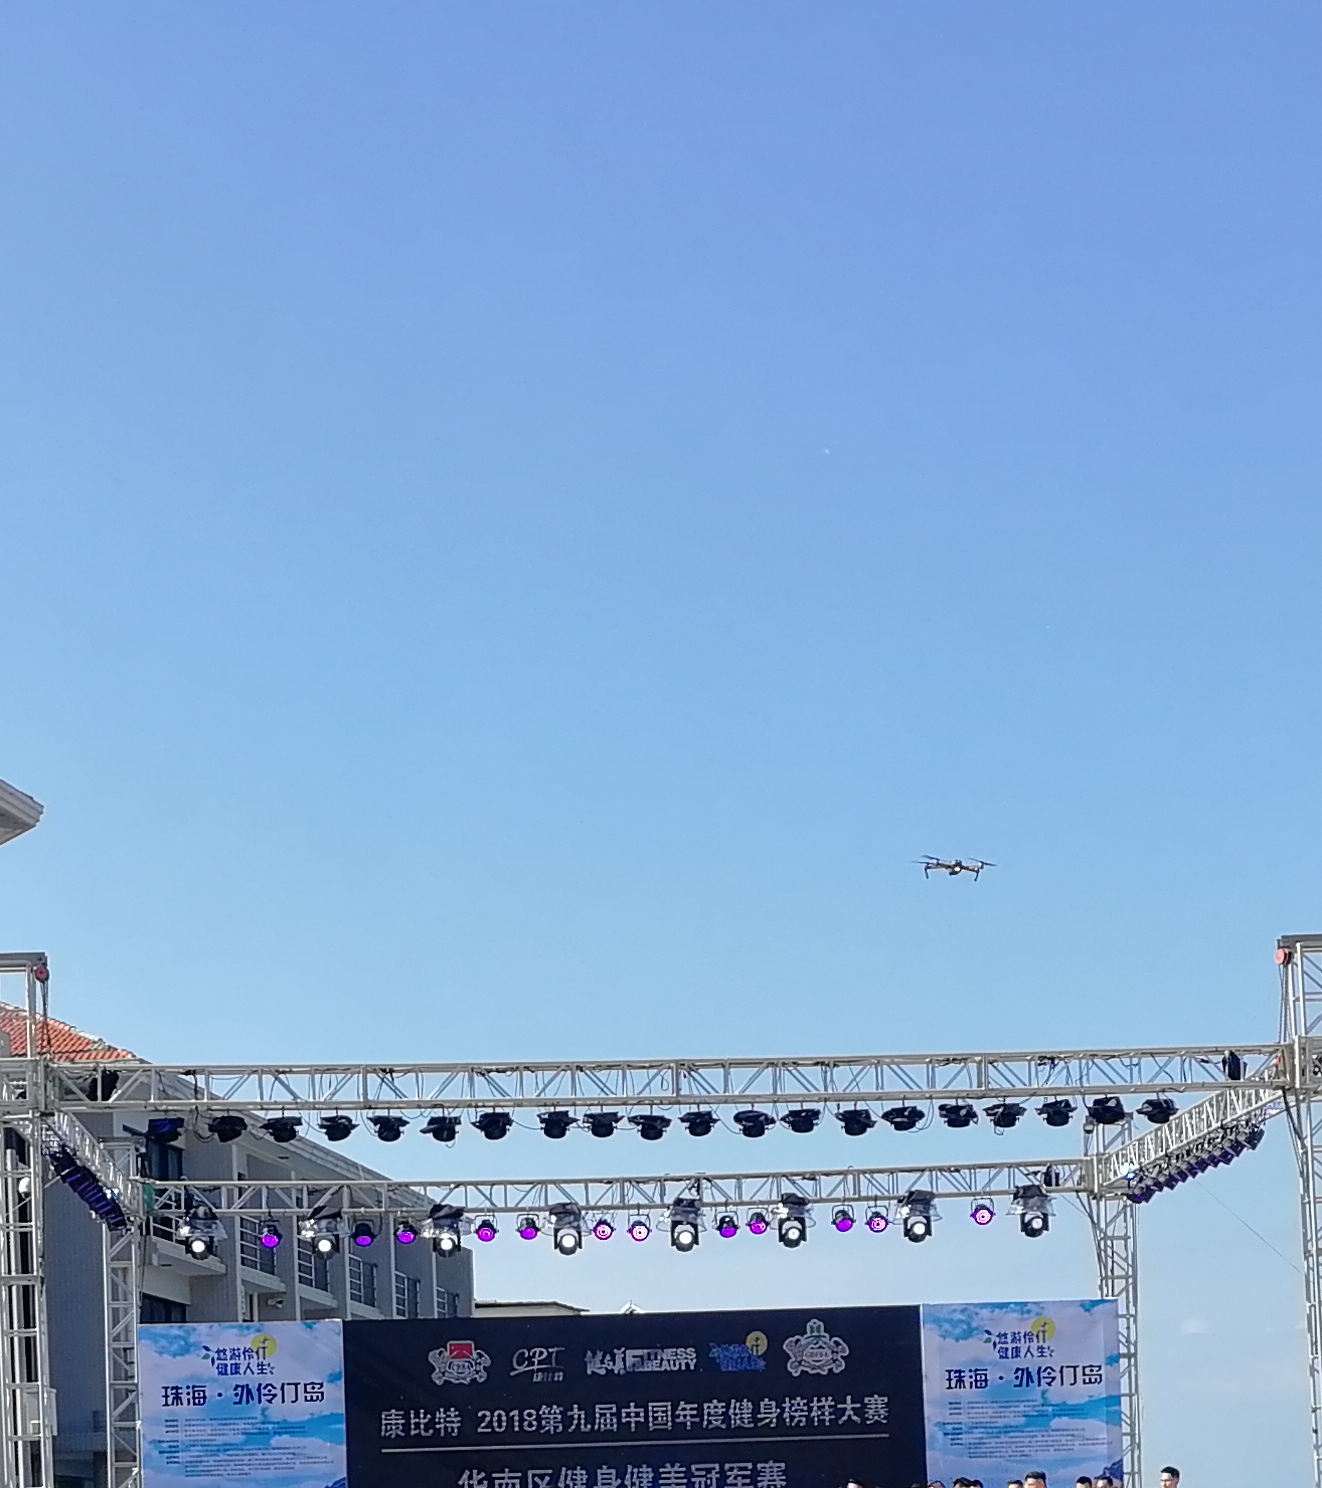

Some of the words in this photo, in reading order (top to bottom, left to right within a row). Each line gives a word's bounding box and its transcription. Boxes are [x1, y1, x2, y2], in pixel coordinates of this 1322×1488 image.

[512, 1347, 565, 1370] CPT
[997, 1346, 1049, 1360] 健康人生
[216, 1362, 270, 1376] 健康人生
[381, 1405, 461, 1439] 康比特
[476, 1394, 890, 1436] 2018第九届中国年度健身榜样大赛
